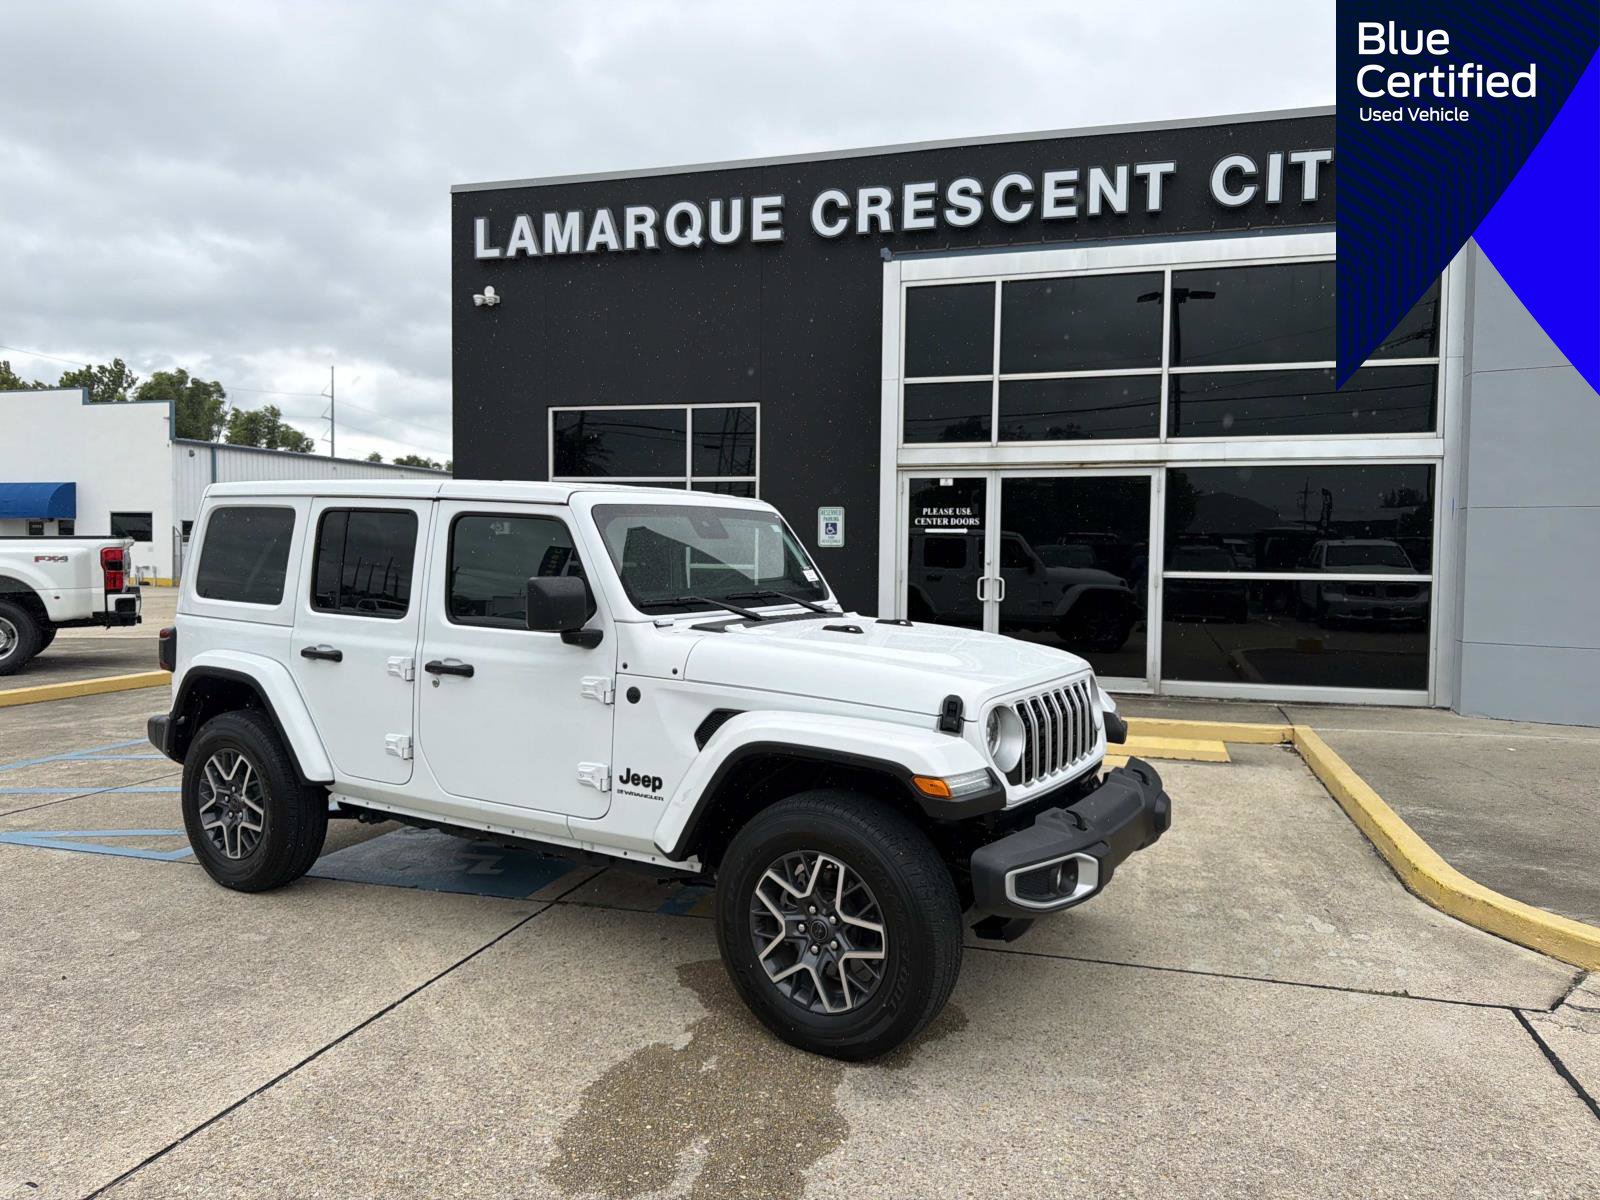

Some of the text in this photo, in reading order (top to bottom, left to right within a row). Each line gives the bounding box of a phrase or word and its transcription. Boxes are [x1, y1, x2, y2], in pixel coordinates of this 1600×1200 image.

[474, 147, 1336, 260] LAMARQUE CRESCENT CIT
[922, 507, 972, 515] PLEASE USE
[914, 517, 980, 525] CENTER DOORS
[619, 767, 663, 793] Jeep
